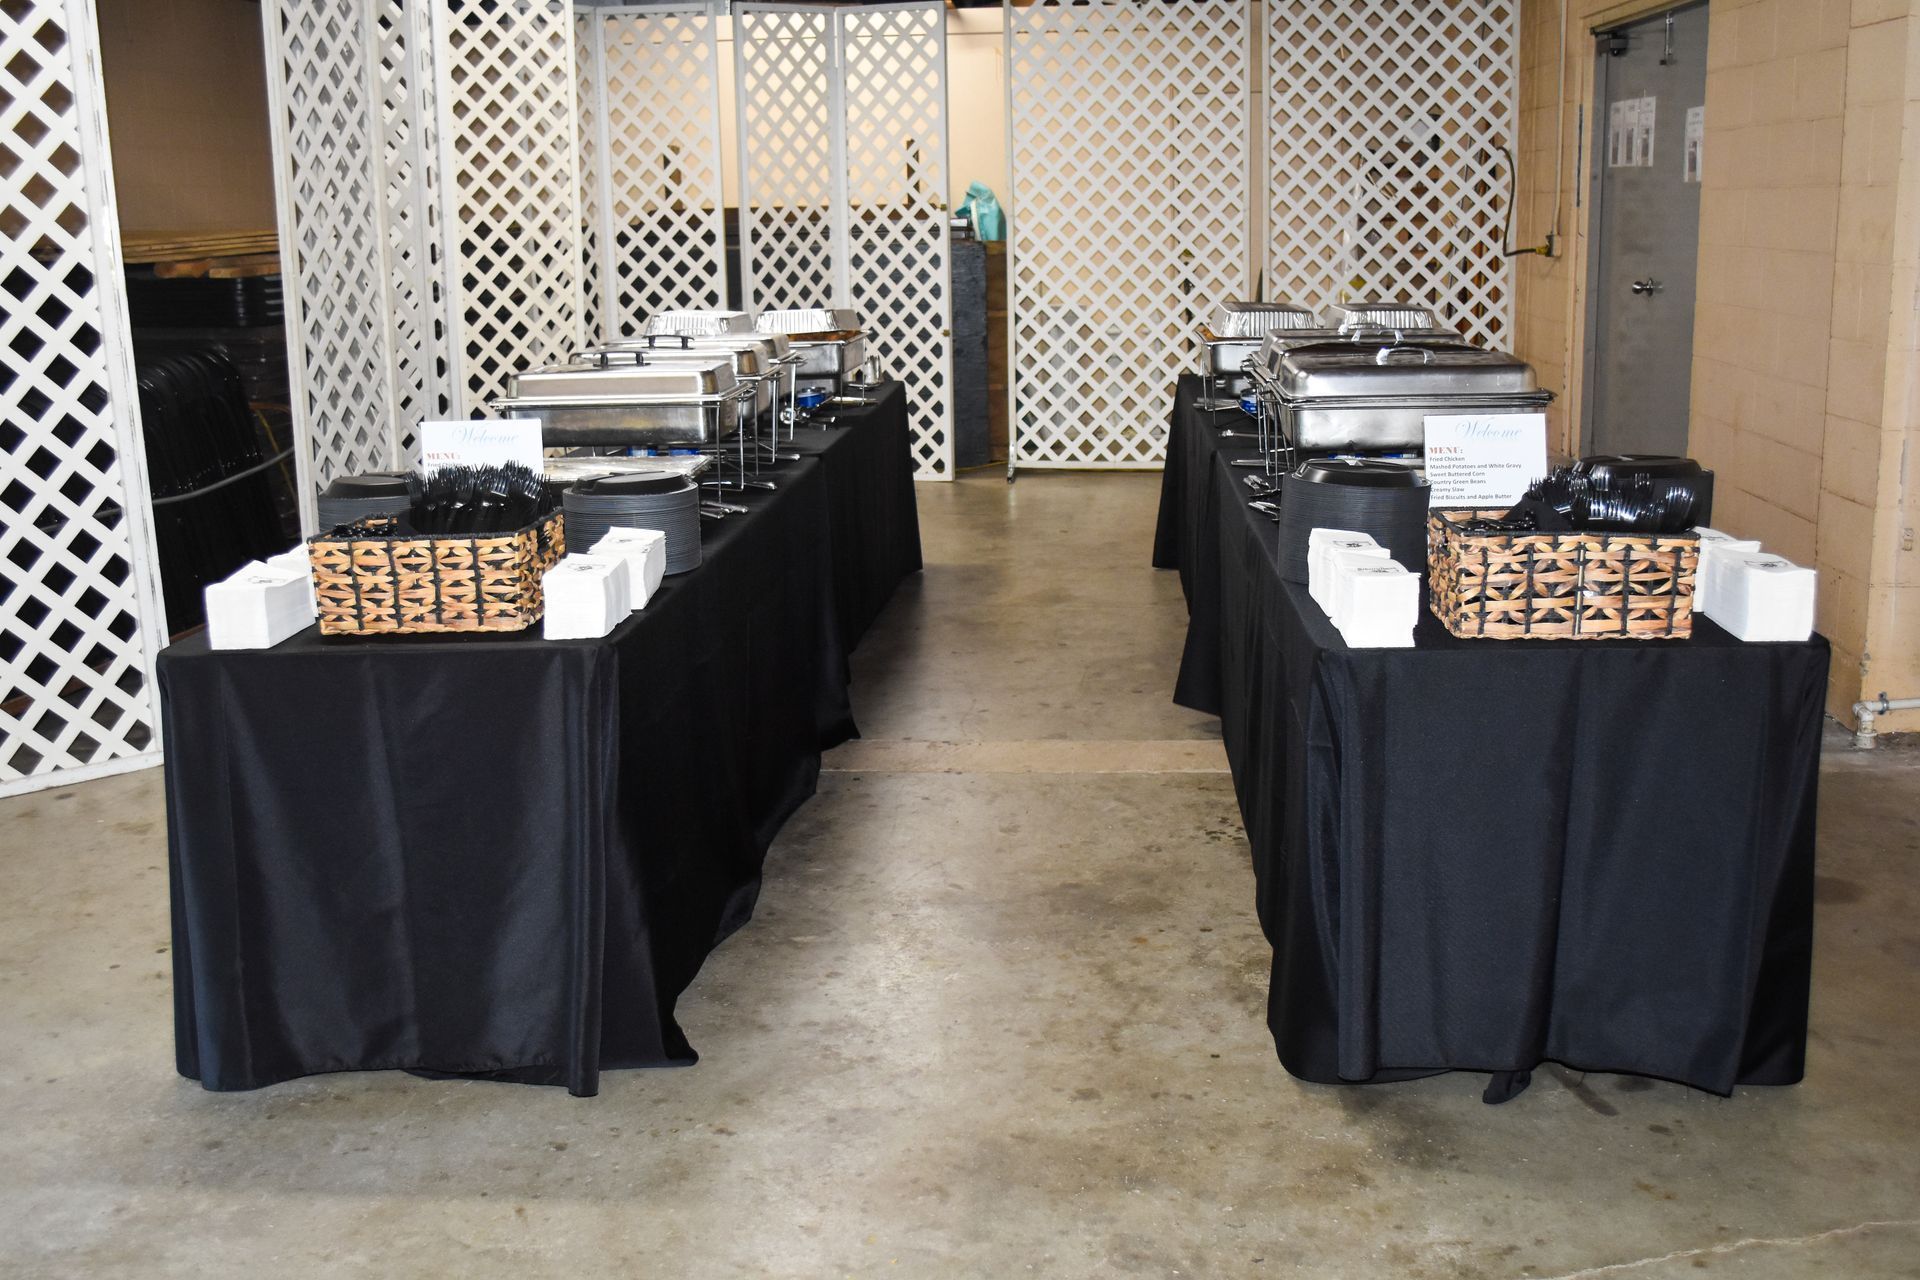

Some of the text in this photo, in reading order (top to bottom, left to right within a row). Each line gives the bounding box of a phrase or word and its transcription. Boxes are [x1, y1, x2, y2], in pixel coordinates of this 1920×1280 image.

[452, 423, 519, 445] Welcome
[1456, 417, 1522, 440] Welcome
[427, 452, 461, 460] MENU:
[1429, 446, 1463, 454] MENU:
